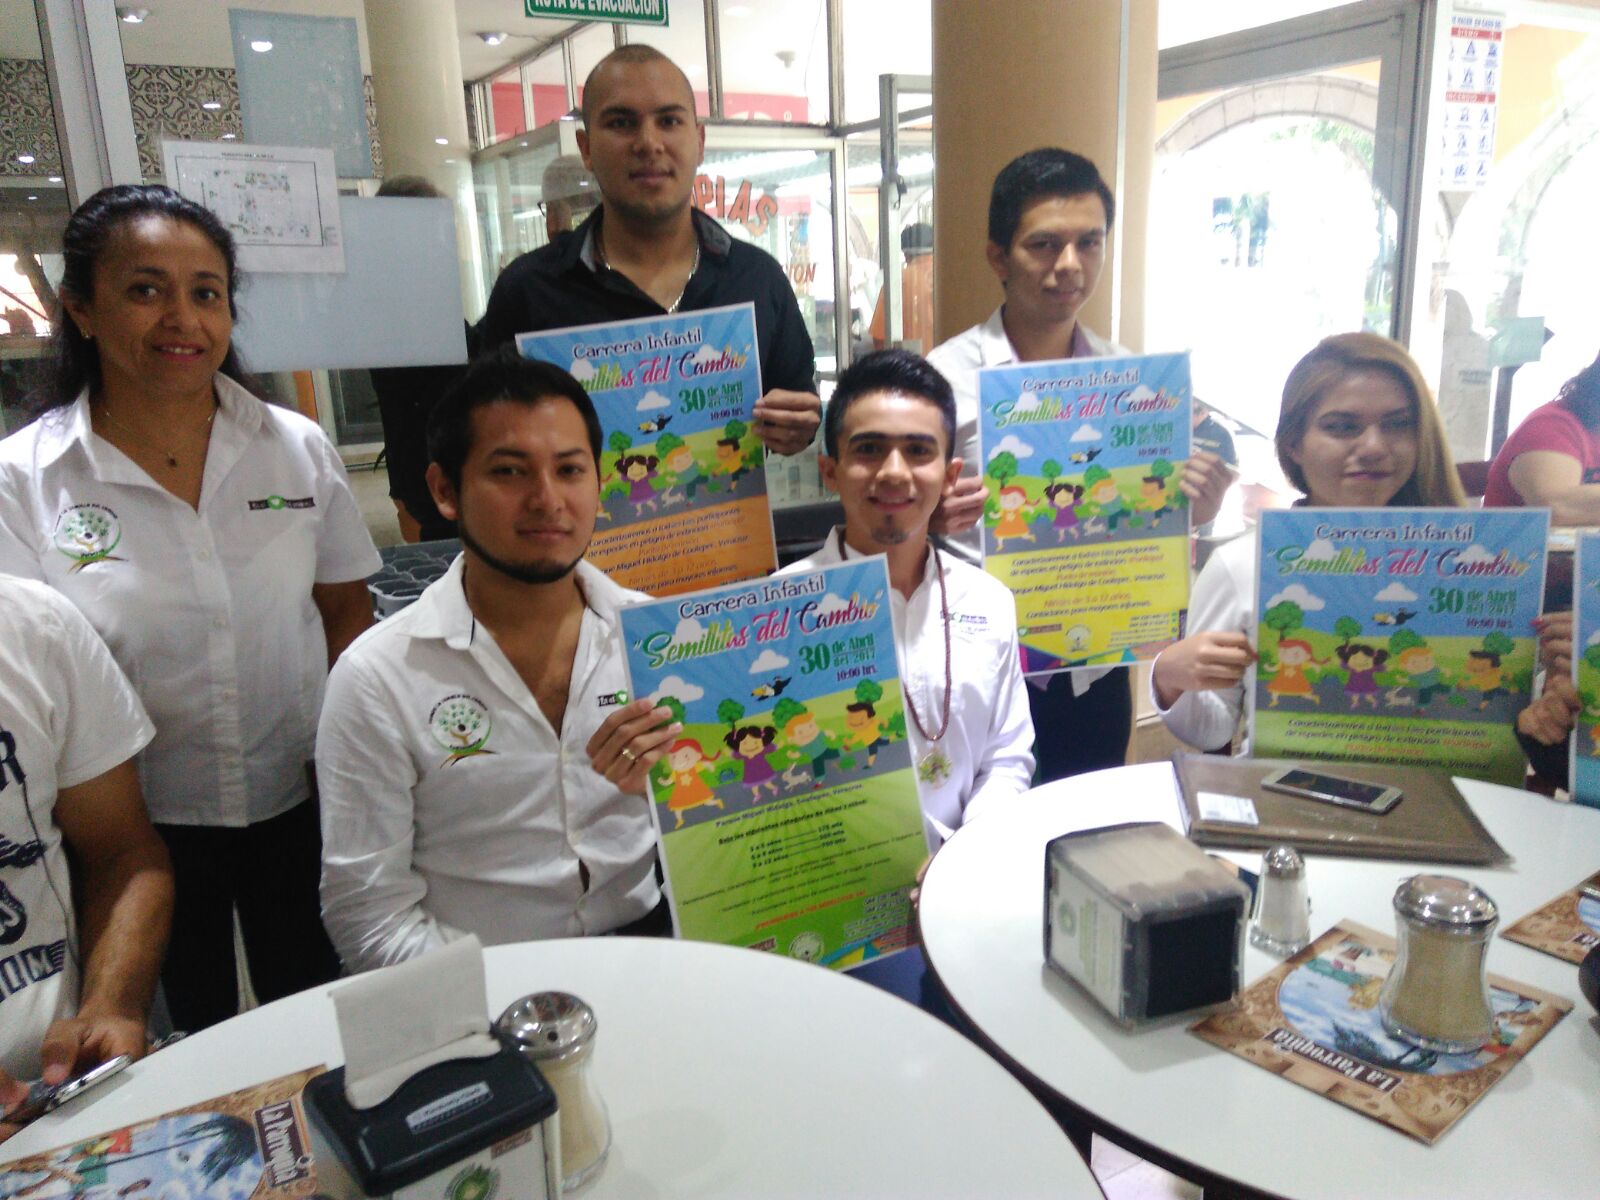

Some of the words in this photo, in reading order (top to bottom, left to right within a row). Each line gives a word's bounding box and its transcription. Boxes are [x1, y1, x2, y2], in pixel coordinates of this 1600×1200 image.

[693, 174, 778, 237] PIAS
[573, 339, 642, 359] Carrera
[648, 327, 702, 349] Infantil
[1023, 375, 1083, 392] Carrera
[1087, 367, 1140, 388] Infantil
[679, 386, 706, 414] 30
[1110, 424, 1135, 448] 30
[1316, 524, 1396, 542] Carrera
[1402, 523, 1473, 543] Infantil
[680, 592, 758, 620] Carrera
[763, 574, 826, 603] Infantil
[1429, 586, 1463, 614] 30
[798, 642, 832, 675] 30
[848, 633, 875, 648] Abril
[1273, 1030, 1364, 1078] Parroquia
[1366, 1070, 1394, 1090] La
